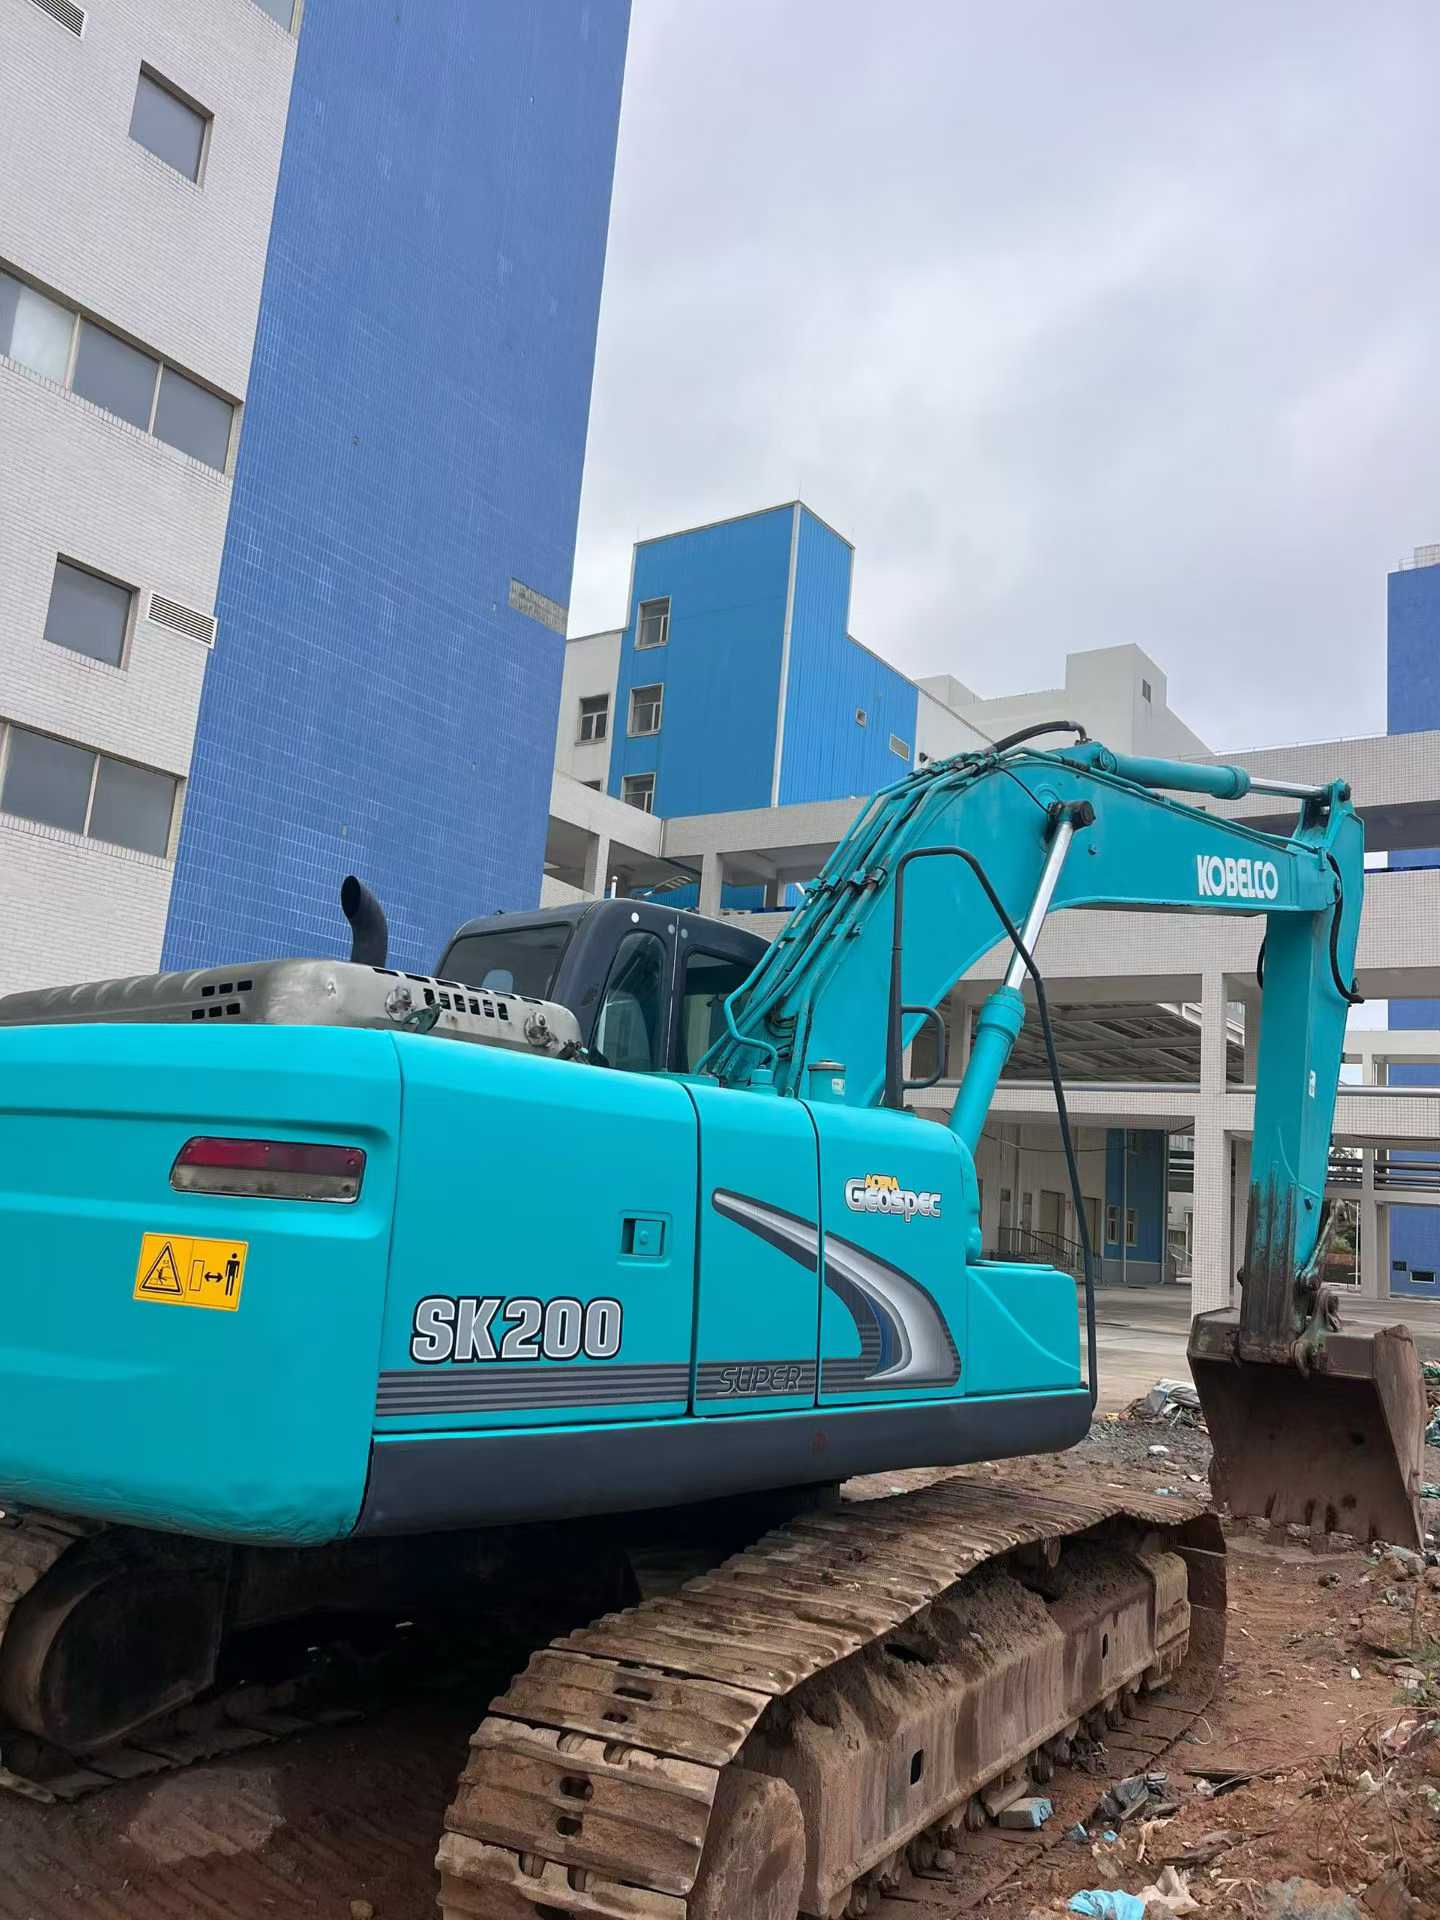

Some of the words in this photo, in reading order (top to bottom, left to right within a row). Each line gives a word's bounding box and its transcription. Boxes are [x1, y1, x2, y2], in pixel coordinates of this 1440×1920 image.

[1196, 854, 1279, 900] KOBELCO
[411, 1295, 623, 1363] SK200
[716, 1366, 802, 1395] SUPER
